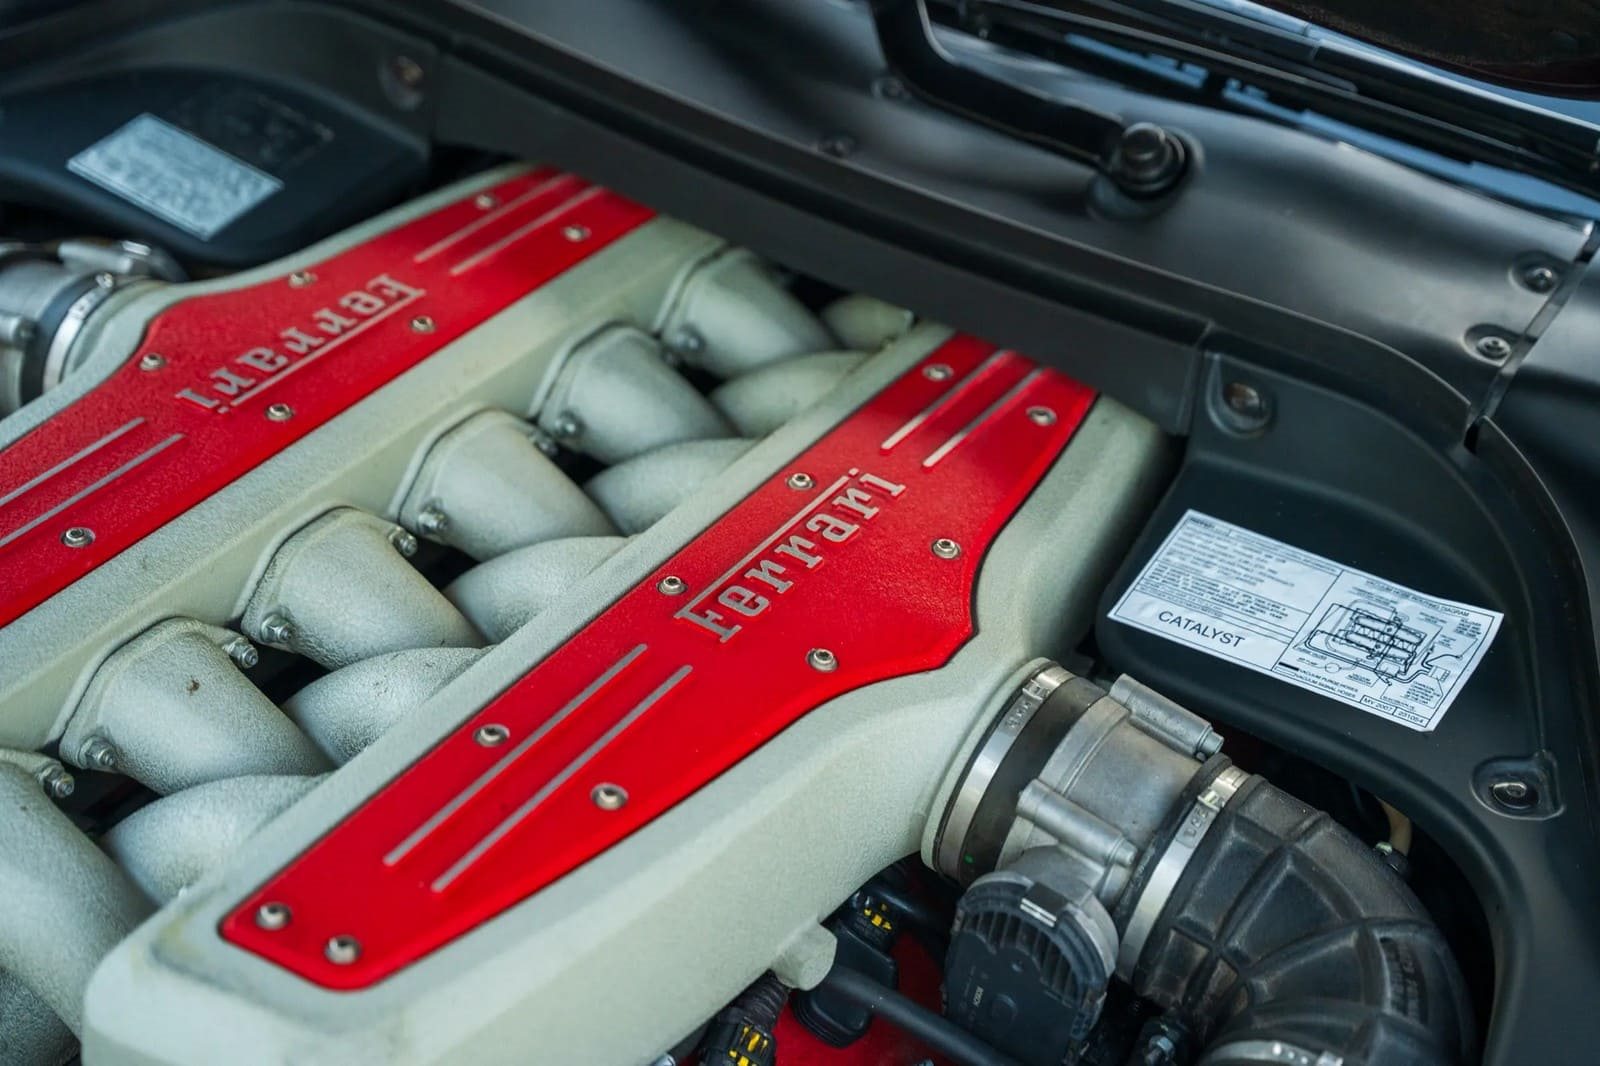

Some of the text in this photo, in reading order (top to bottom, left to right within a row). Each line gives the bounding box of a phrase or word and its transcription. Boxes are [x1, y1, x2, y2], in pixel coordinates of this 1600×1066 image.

[175, 273, 426, 413] Ferrari
[673, 468, 906, 643] Ferrari
[1440, 606, 1470, 617] DIAGRAM
[1159, 611, 1245, 648] CATALYST
[1364, 697, 1375, 706] MY
[1374, 701, 1393, 712] 2007
[1398, 710, 1424, 724] 231054
